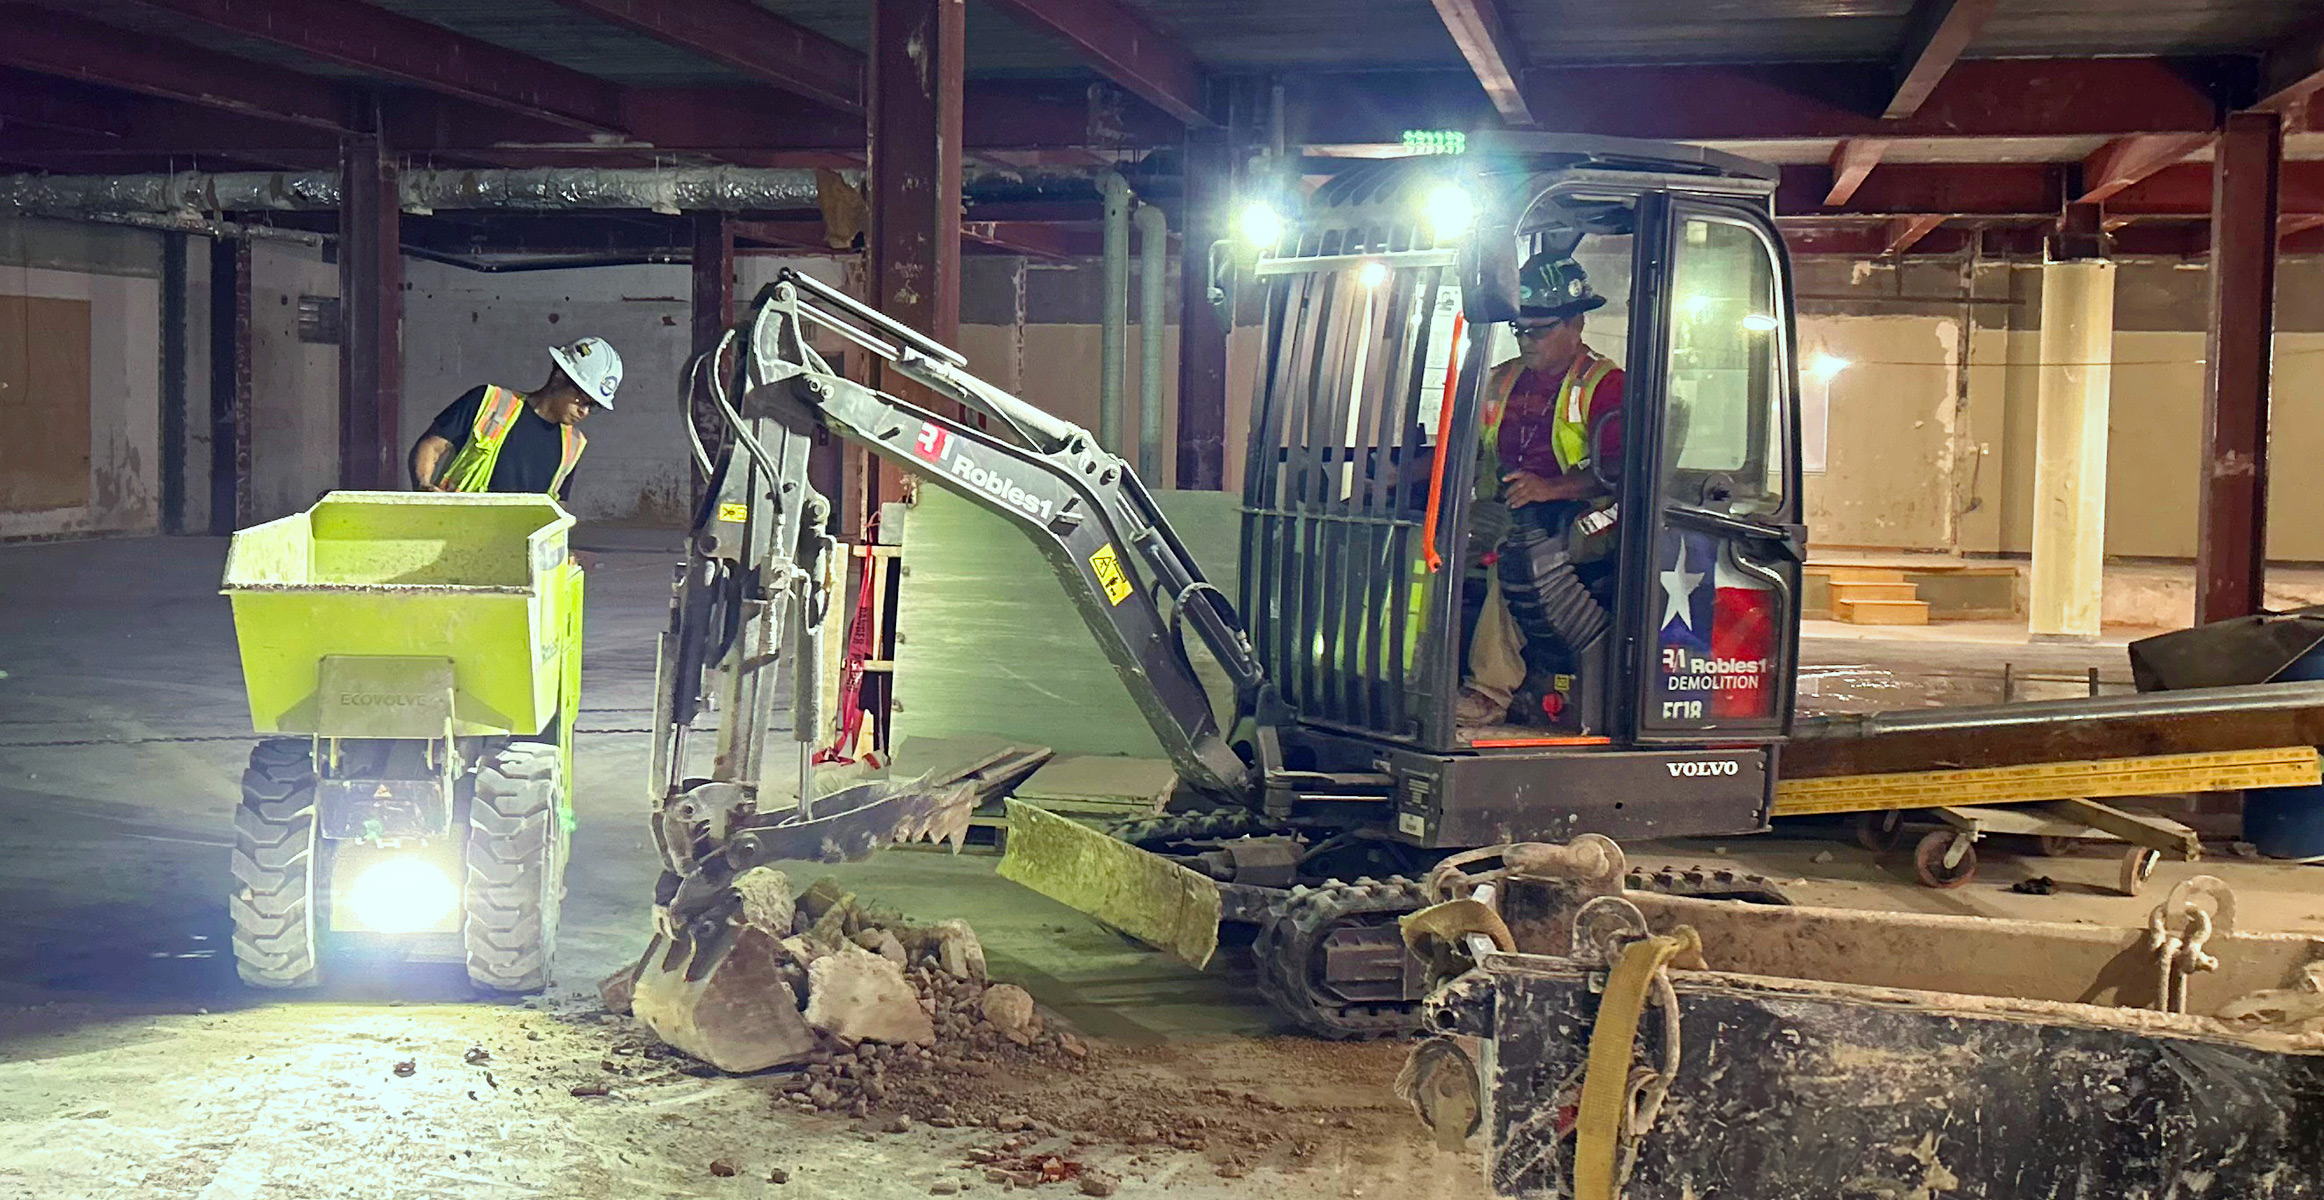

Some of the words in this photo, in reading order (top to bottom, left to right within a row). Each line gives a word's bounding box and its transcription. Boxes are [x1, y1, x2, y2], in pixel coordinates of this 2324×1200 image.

[950, 453, 1053, 520] Robles1
[1690, 657, 1767, 674] Robles1
[1668, 675, 1759, 690] DEMOLITION
[340, 693, 428, 706] ECOVOLVE
[1666, 760, 1739, 777] VOLVO
